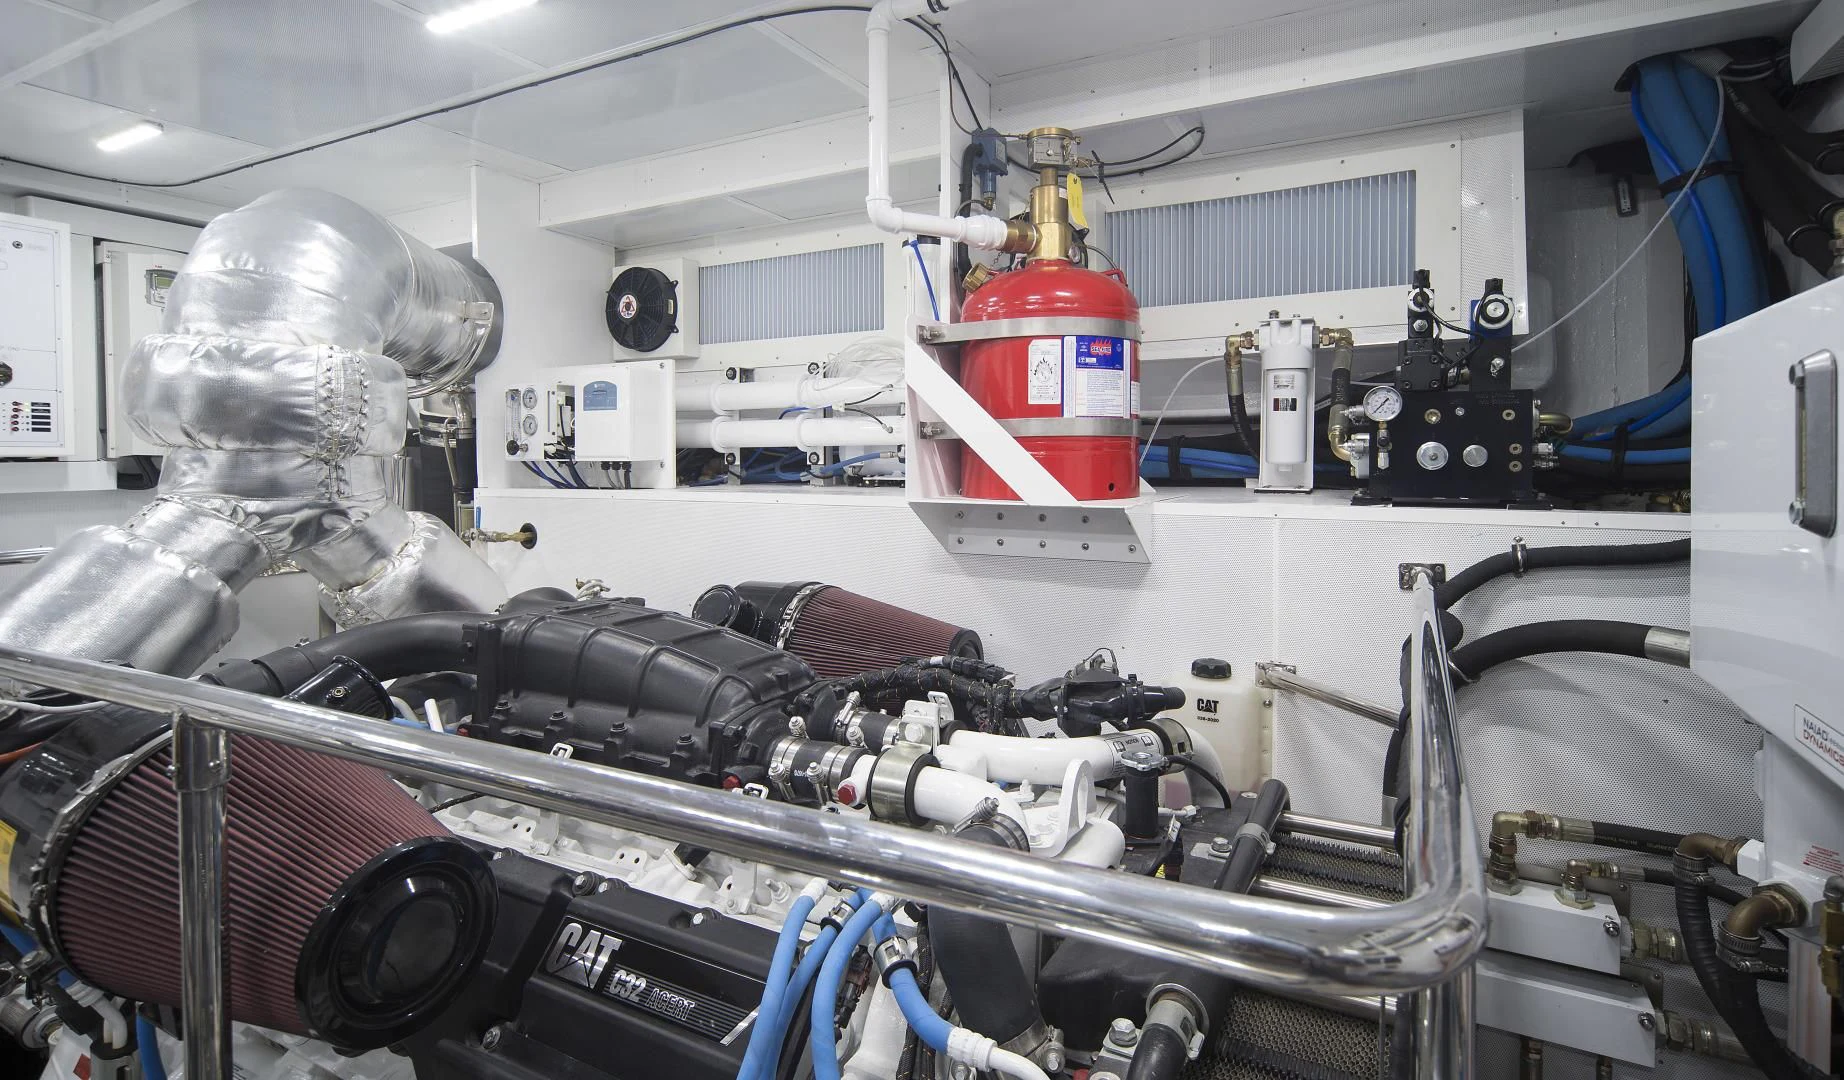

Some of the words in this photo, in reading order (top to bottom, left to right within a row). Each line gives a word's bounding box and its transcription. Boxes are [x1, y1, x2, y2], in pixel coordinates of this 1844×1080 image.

[1197, 698, 1219, 713] CAT
[1803, 717, 1828, 741] NAIAD
[546, 922, 623, 989] CAT
[609, 970, 647, 1003] C32
[645, 988, 696, 1021] ACERT
